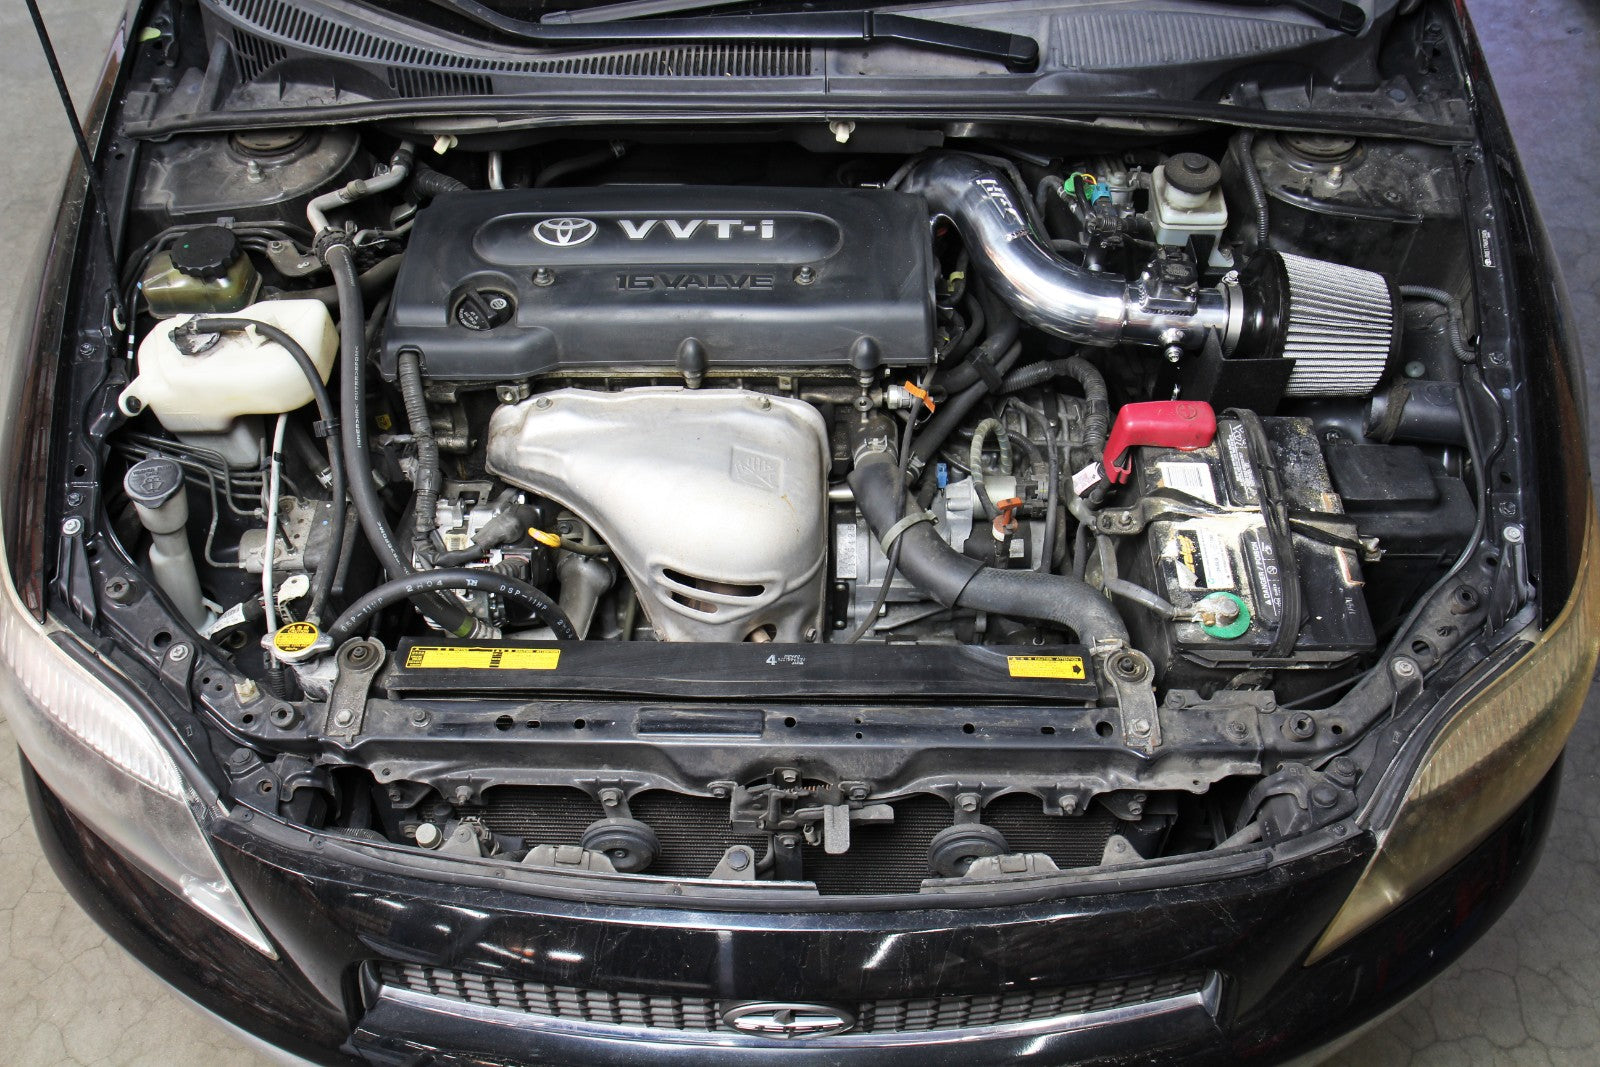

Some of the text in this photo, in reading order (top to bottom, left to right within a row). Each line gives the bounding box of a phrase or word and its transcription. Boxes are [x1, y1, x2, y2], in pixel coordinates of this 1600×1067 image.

[617, 219, 775, 240] VVT-i
[616, 274, 774, 291] 16 VALVE
[1250, 541, 1263, 565] POISON
[1258, 571, 1272, 599] DANGER
[765, 654, 778, 666] 4
